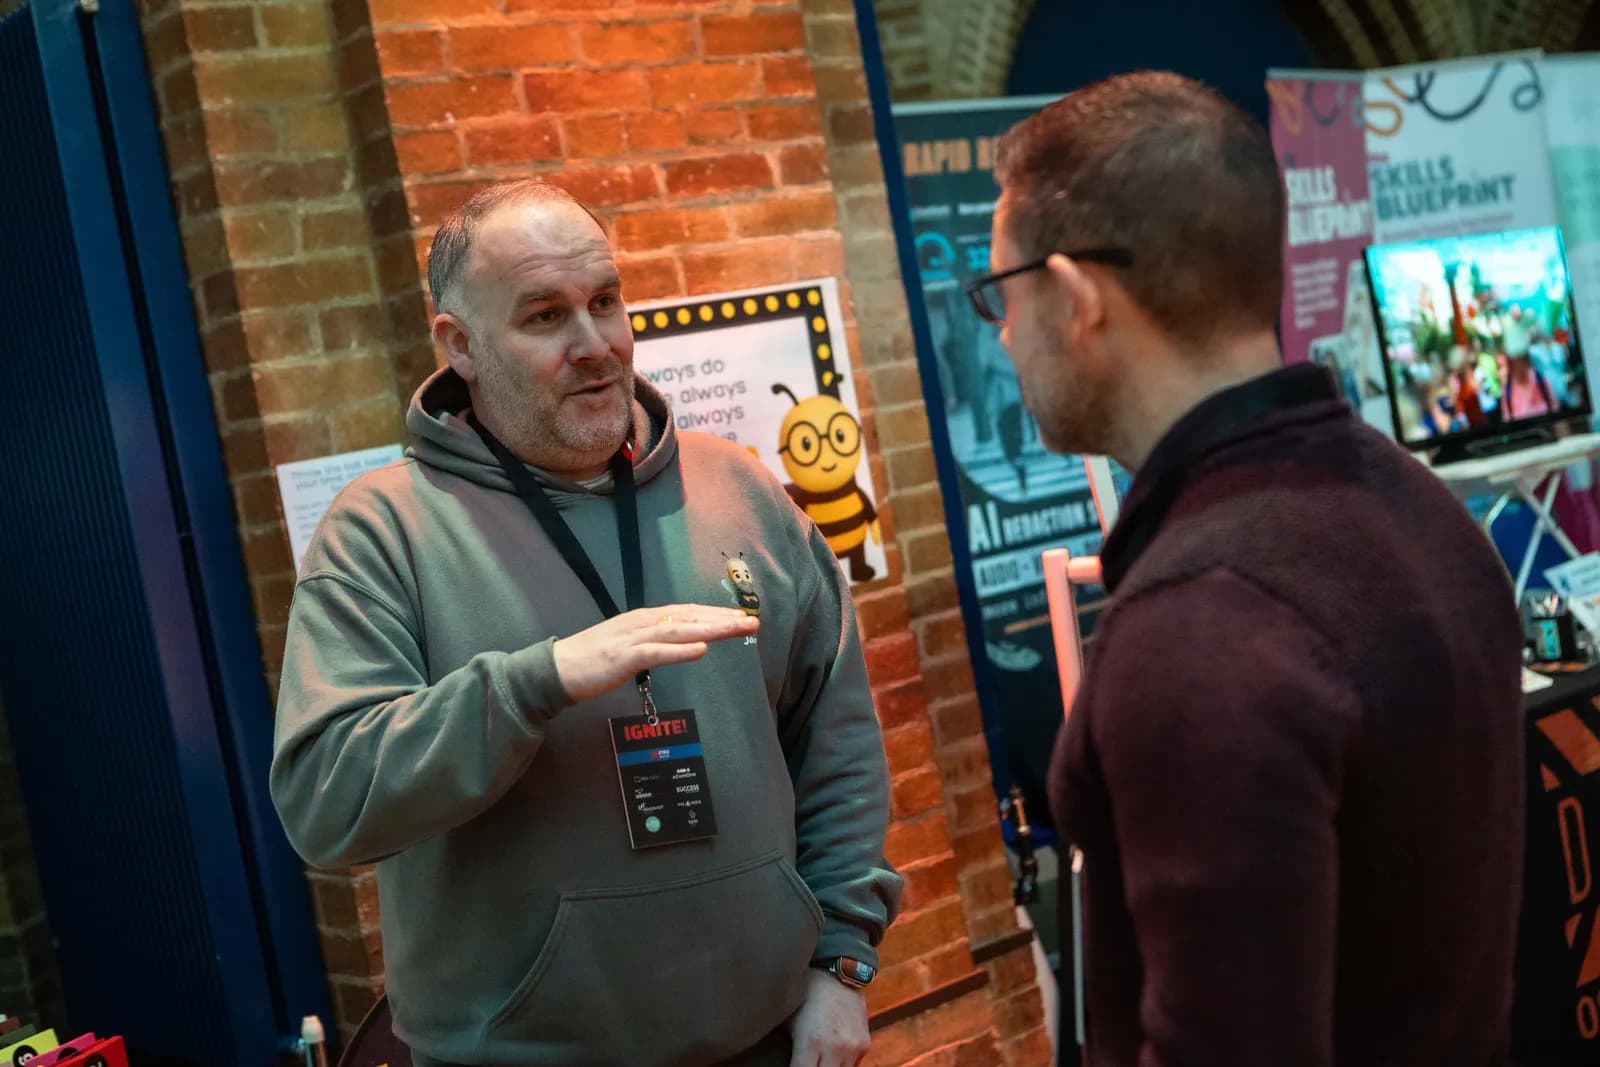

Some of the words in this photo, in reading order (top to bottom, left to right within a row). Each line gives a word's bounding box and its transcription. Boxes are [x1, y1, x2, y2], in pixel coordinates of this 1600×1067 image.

[903, 139, 970, 176] RAPID
[1370, 154, 1456, 191] SKILLS
[700, 359, 725, 375] do
[680, 380, 747, 404] always
[676, 405, 745, 430] always
[967, 501, 1002, 556] AI
[1003, 503, 1087, 546] REDACTION
[623, 718, 688, 742] IGNITE!
[676, 784, 700, 794] SUCCESS
